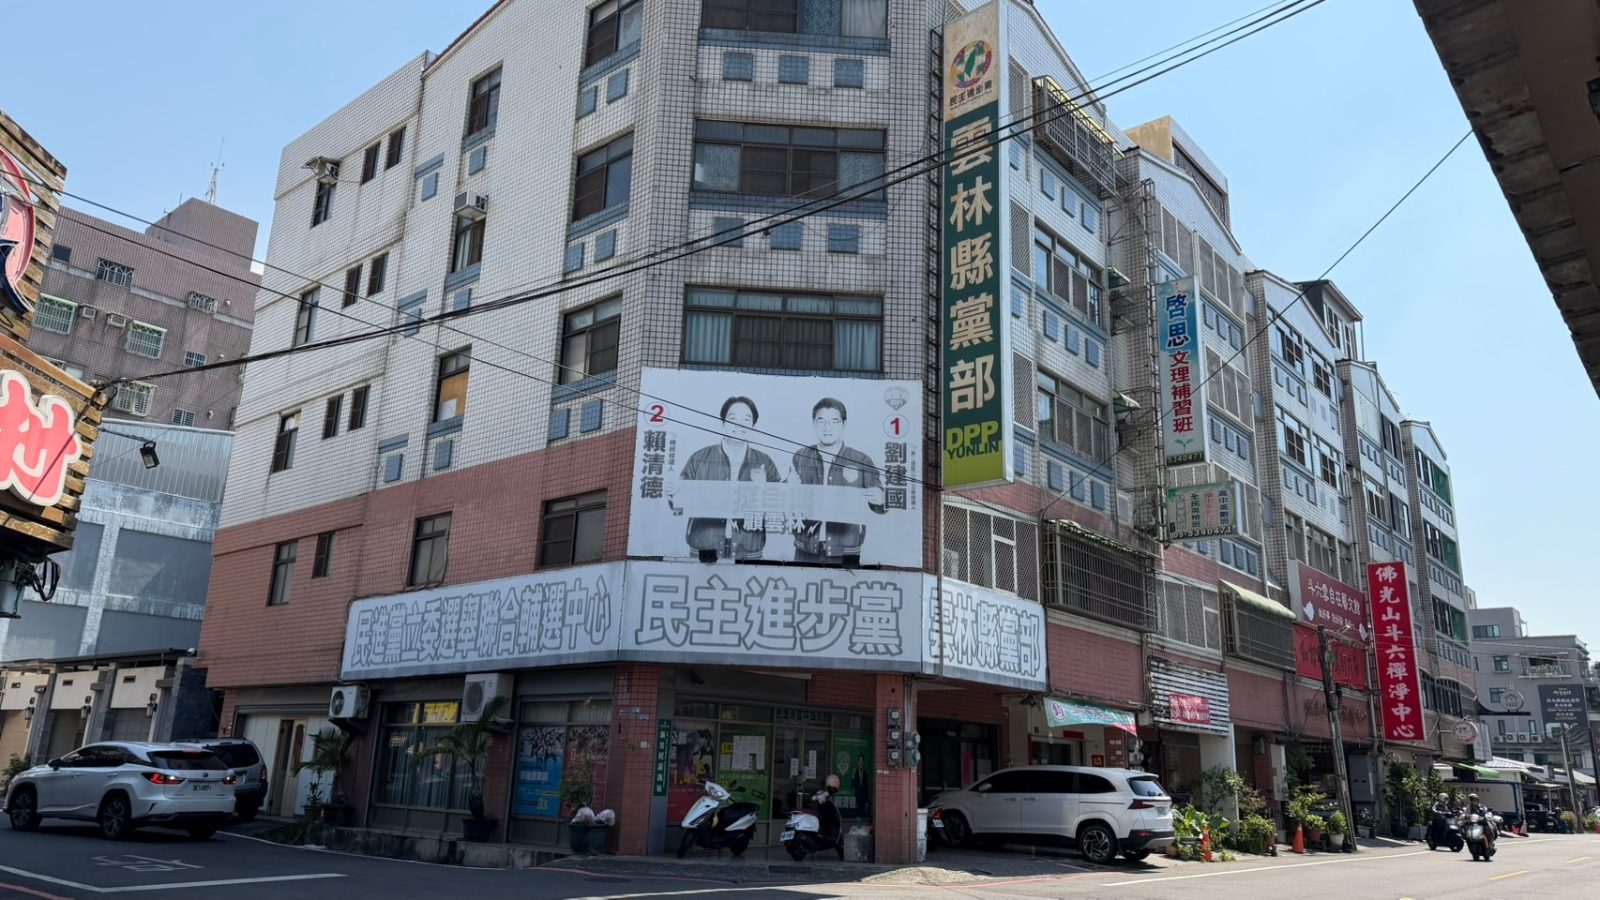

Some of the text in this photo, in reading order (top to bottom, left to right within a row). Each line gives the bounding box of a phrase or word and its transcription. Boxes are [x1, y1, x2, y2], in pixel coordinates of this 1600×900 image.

[950, 80, 992, 107] 民主進步黨
[949, 116, 995, 414] 雲林縣黨部
[650, 405, 664, 423] 2
[890, 417, 900, 435] 1
[946, 420, 999, 450] DPP
[639, 429, 667, 499] 賴清德
[884, 441, 908, 510] 劉建國
[948, 440, 999, 460] YUNLIN
[351, 574, 611, 667] 民進黨立委選舉聯合輔選中心
[635, 573, 903, 656] 民主進步黨
[929, 586, 1041, 678] 雲林縣黨部
[1375, 565, 1416, 738] 佛光山斗六禪淨中心
